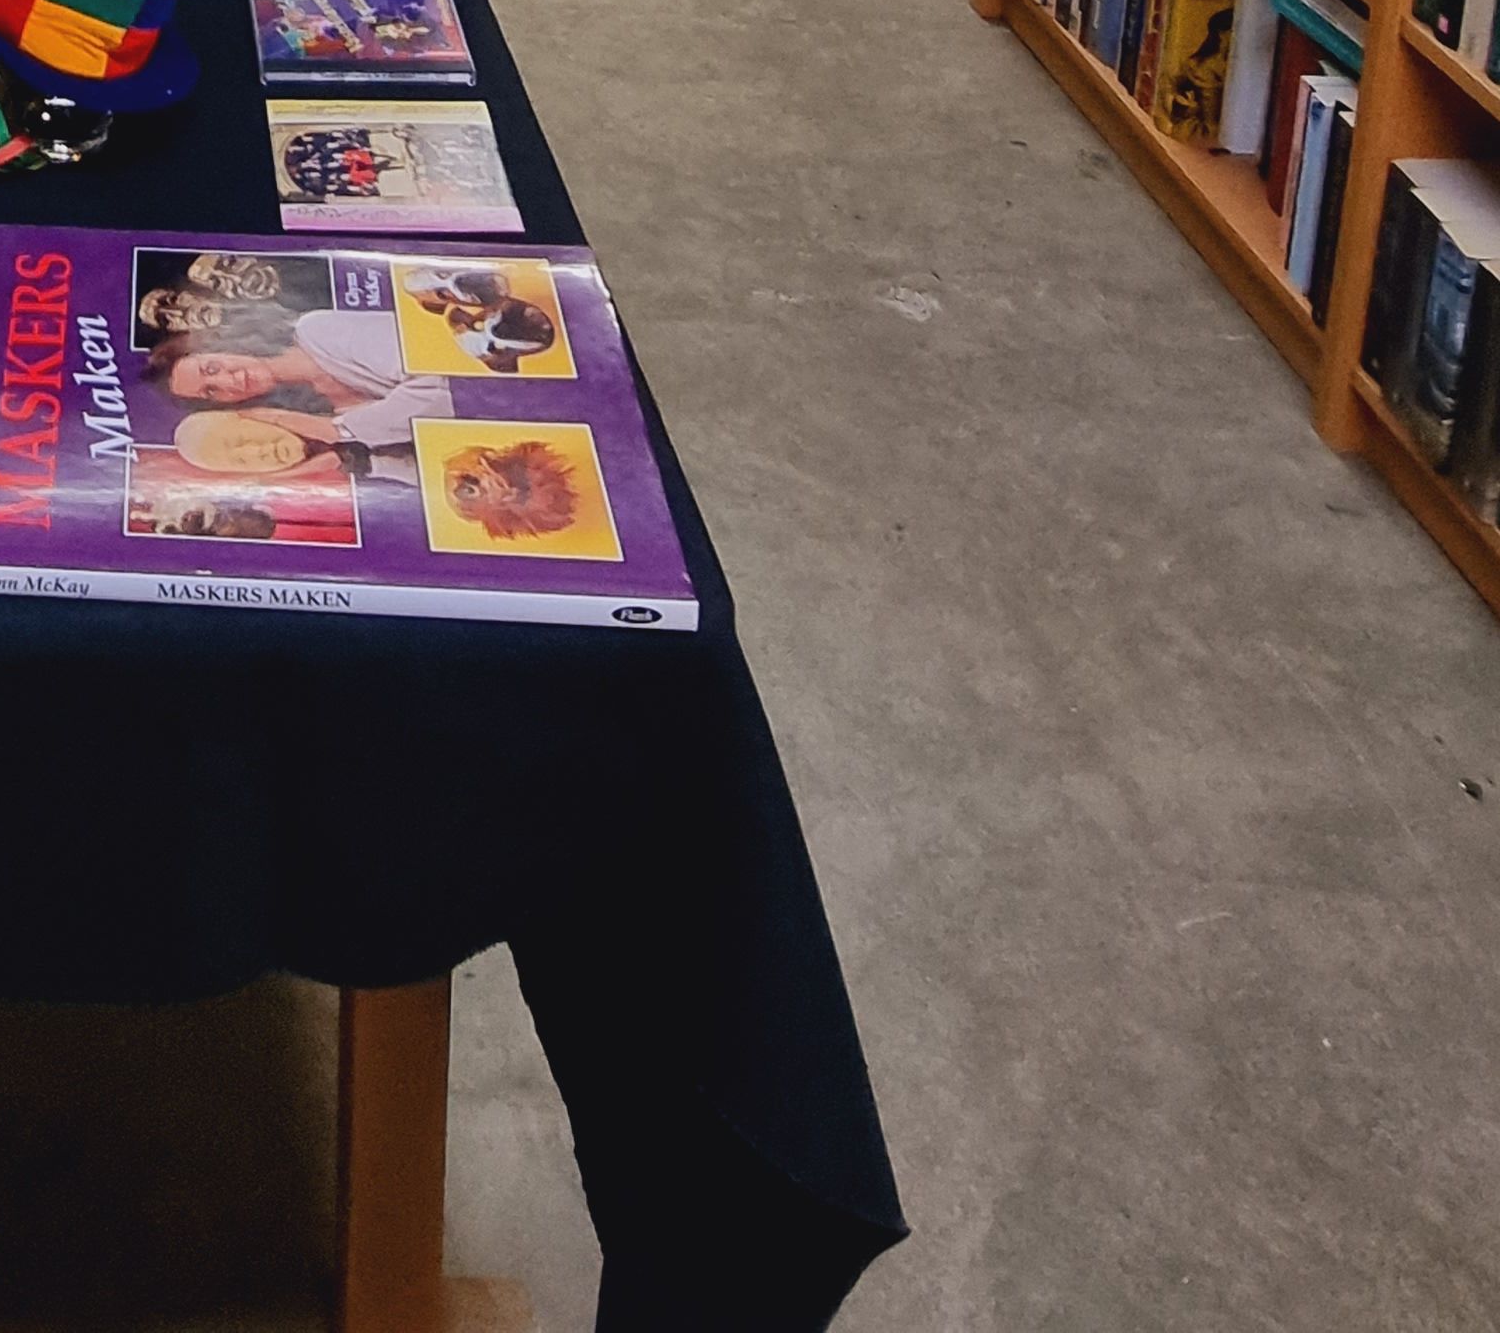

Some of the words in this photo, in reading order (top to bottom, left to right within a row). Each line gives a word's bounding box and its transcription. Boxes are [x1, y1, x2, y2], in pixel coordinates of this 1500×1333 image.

[73, 313, 140, 462] Maken
[21, 574, 90, 597] McKay
[157, 581, 262, 605] MASKERS
[268, 587, 352, 610] MAKEN
